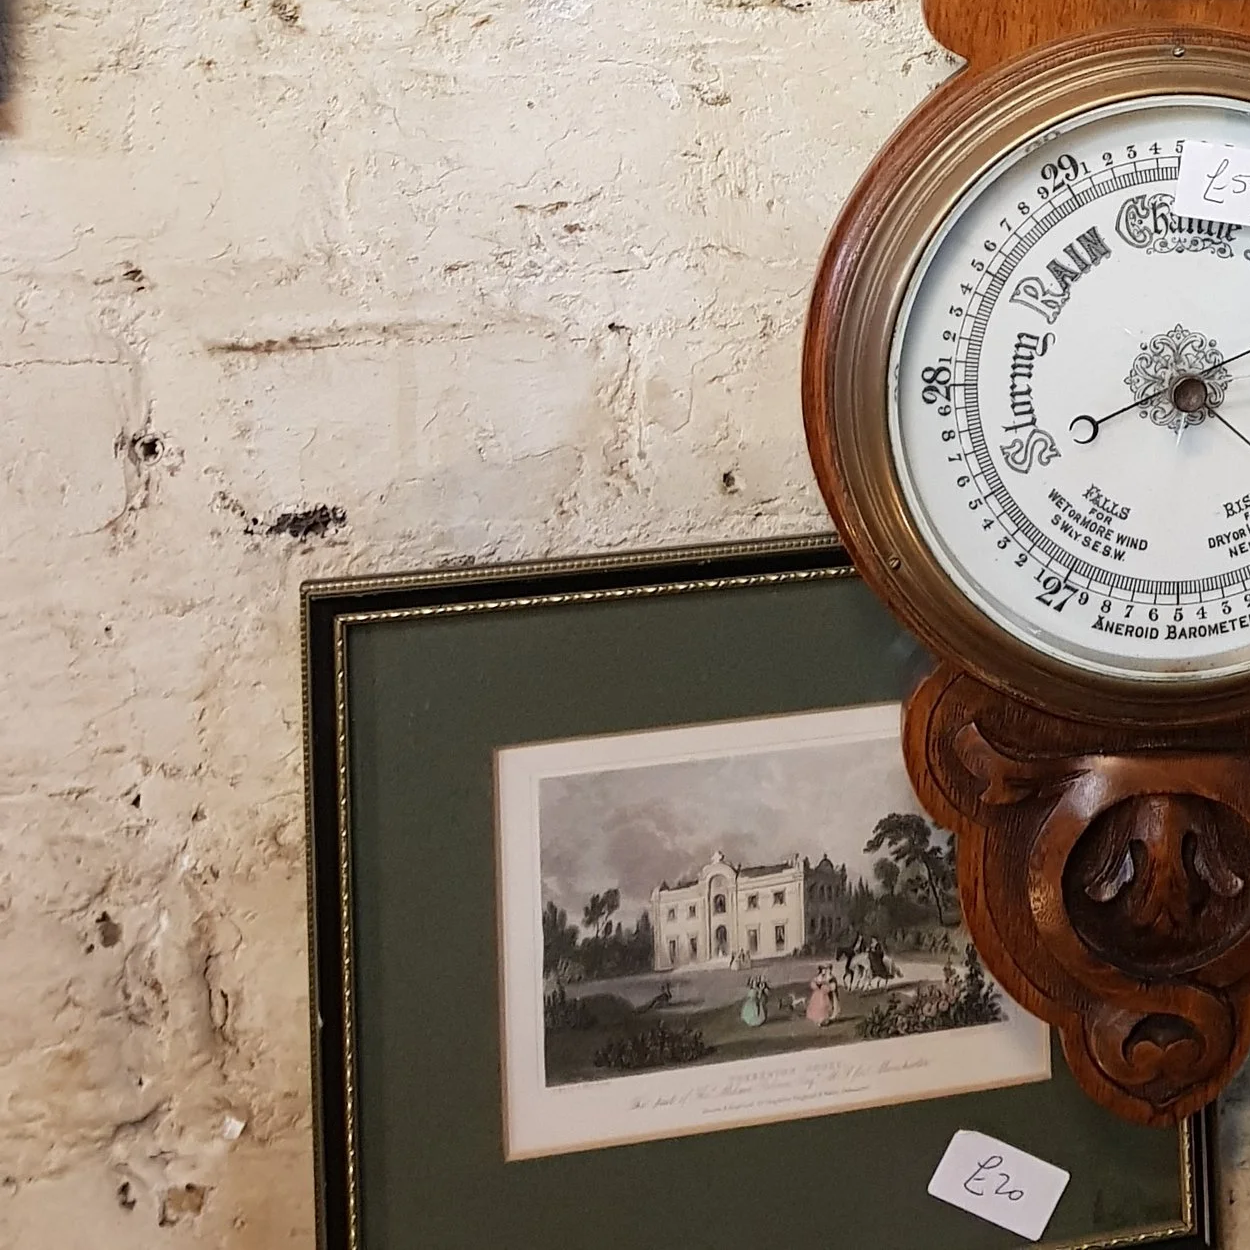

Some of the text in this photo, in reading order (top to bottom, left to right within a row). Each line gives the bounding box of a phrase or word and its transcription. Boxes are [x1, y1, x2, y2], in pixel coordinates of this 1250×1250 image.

[1126, 145, 1138, 159] 3
[1148, 142, 1162, 155] 4
[1102, 152, 1114, 166] 2
[1041, 154, 1079, 193] 29
[1079, 161, 1092, 176] 1
[1036, 186, 1050, 200] 9
[1017, 201, 1031, 215] 8
[1000, 217, 1013, 232] 7
[983, 239, 998, 252] 6
[970, 258, 985, 272] 5
[1009, 225, 1112, 324] RAIN
[959, 282, 973, 296] 4
[949, 305, 963, 317] 3
[942, 330, 957, 343] 2
[938, 356, 952, 365] 1
[921, 366, 952, 405] 28
[941, 428, 956, 442] 8
[947, 452, 963, 464] 7
[956, 475, 971, 488] 6
[968, 498, 983, 511] 5
[1082, 483, 1131, 521] FALLS
[1088, 507, 1113, 526] FOR
[982, 517, 995, 532] 4
[997, 536, 1012, 550] 3
[1116, 533, 1149, 552] WIND
[1014, 553, 1029, 567] 2
[1033, 568, 1046, 583] 1
[1035, 575, 1079, 612] 27
[1078, 591, 1090, 606] 9
[1100, 599, 1112, 613] 8
[1124, 604, 1134, 619] 7
[1195, 606, 1208, 620] 4
[1221, 601, 1232, 615] 3
[1148, 607, 1159, 622] 6
[1173, 607, 1184, 622] 5
[1091, 614, 1160, 640] ANEROID
[963, 1155, 1025, 1201] £20
